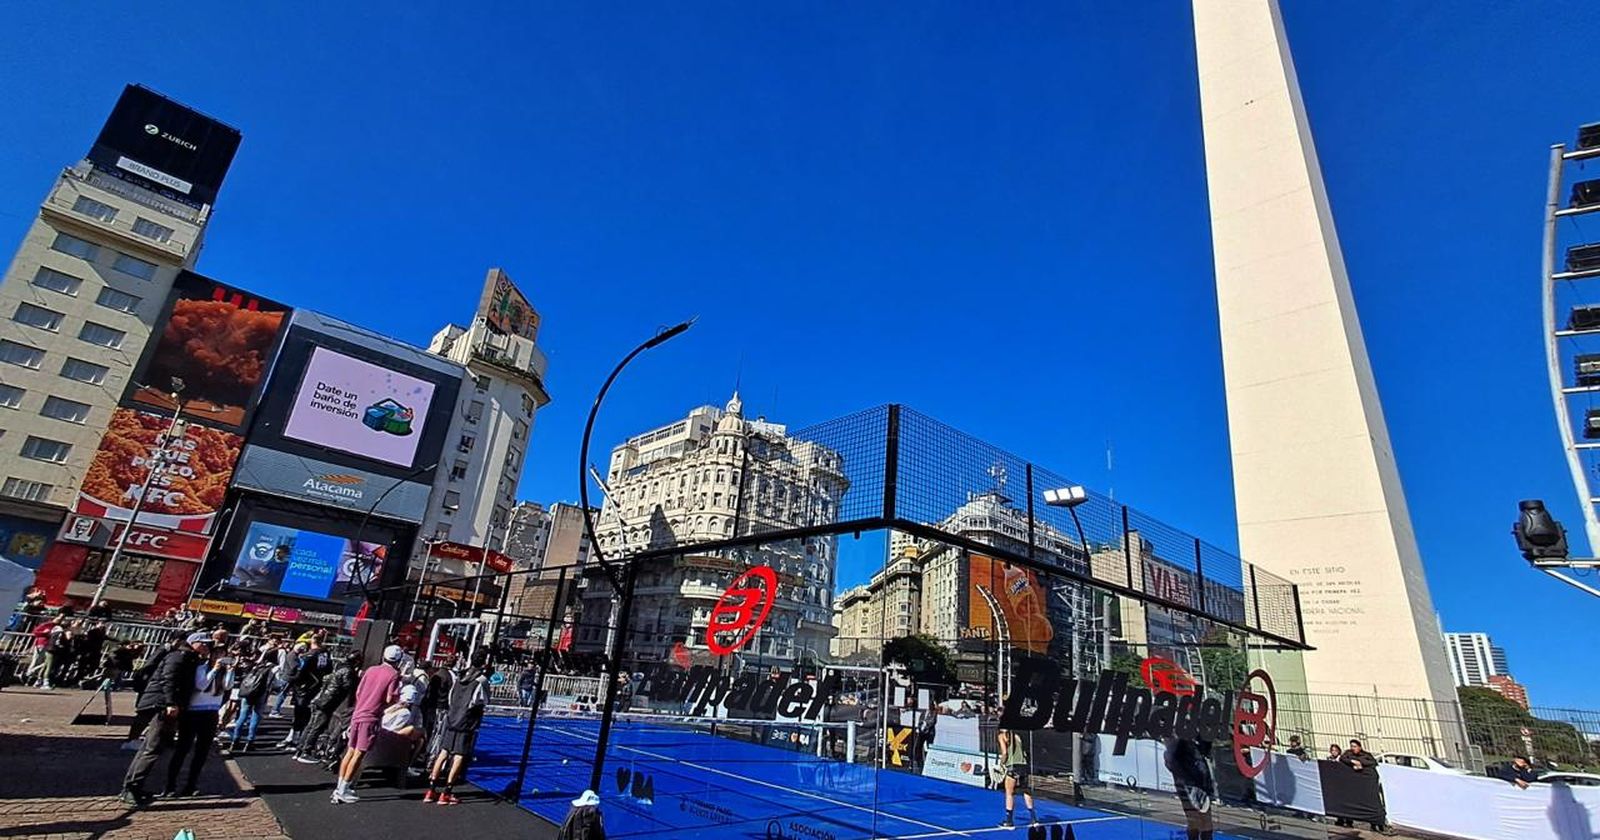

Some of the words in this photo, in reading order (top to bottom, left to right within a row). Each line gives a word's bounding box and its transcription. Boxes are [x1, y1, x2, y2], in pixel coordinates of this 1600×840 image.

[161, 132, 197, 151] ZURICH
[129, 161, 160, 180] BRAND
[160, 173, 182, 188] PLUS
[313, 390, 341, 405] baño
[343, 399, 357, 410] de
[316, 381, 342, 396] Date
[344, 391, 358, 401] un
[310, 399, 359, 420] inversión
[303, 477, 363, 499] Atacama
[114, 529, 168, 549] KFC
[290, 561, 333, 574] personal
[959, 626, 991, 638] FANTA
